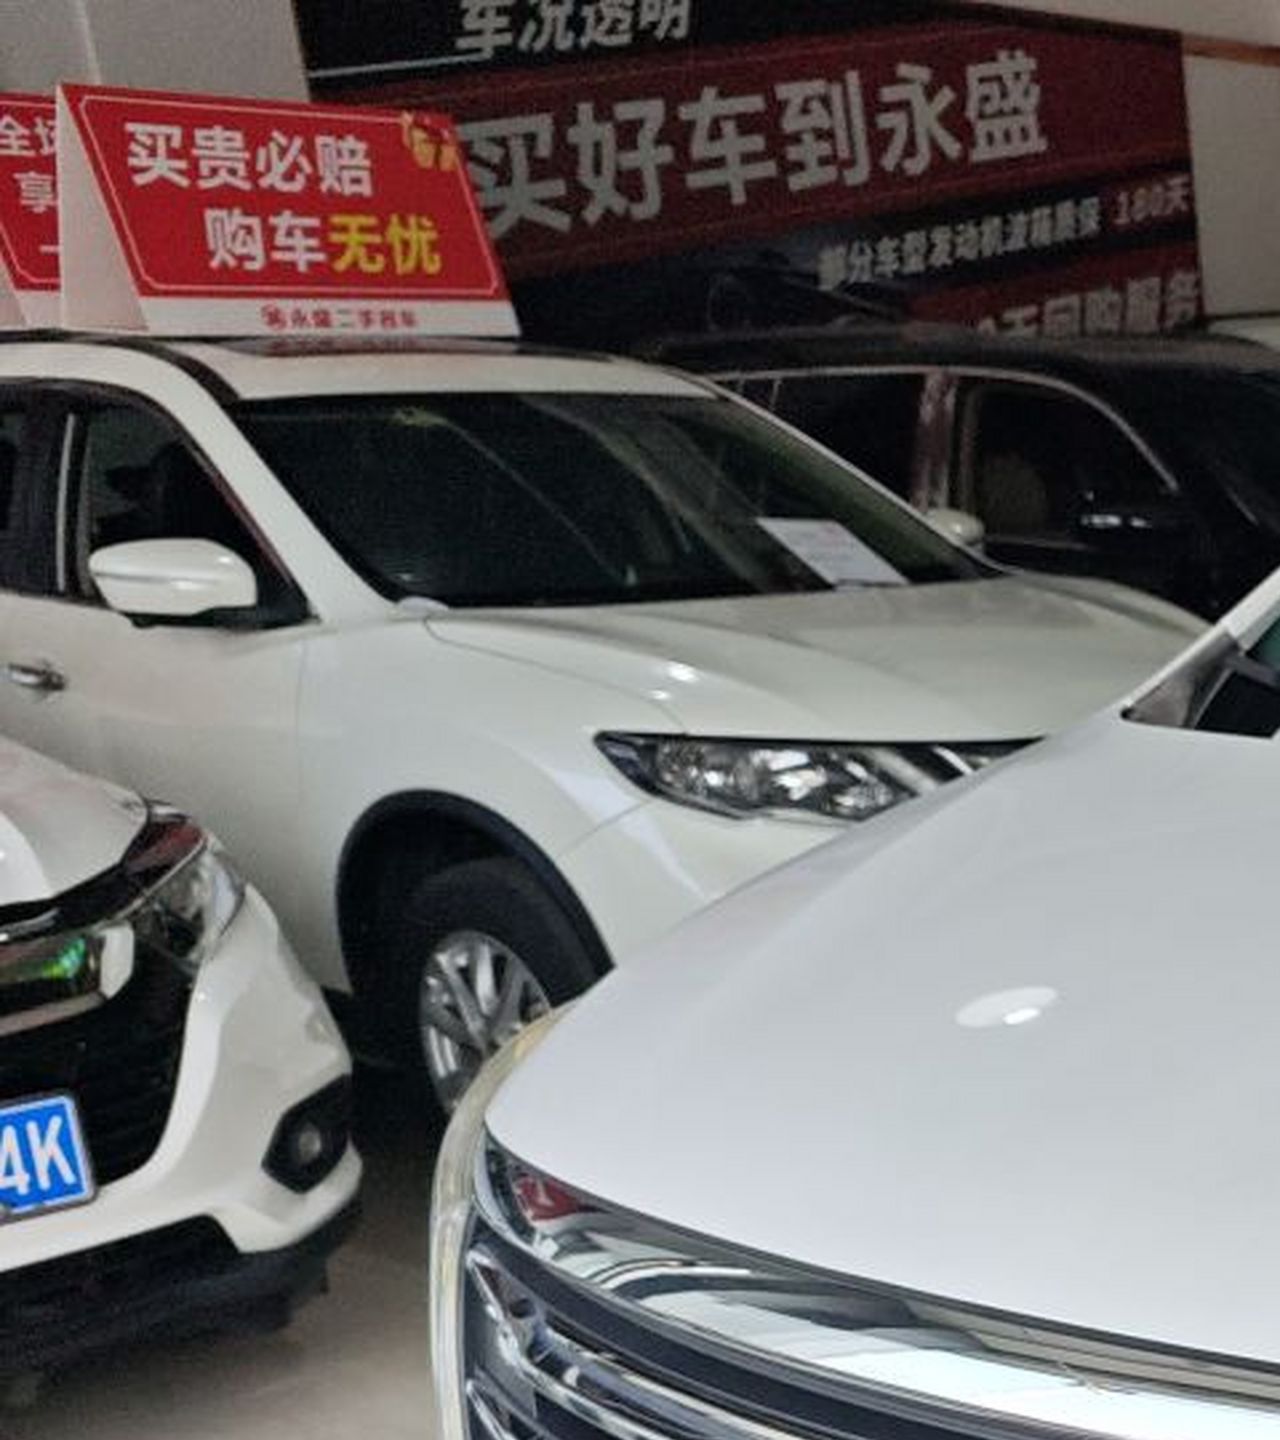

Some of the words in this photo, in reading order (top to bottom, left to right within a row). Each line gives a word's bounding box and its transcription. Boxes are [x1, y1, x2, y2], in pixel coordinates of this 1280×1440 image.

[454, 0, 692, 57] 车况透明
[125, 121, 373, 197] 买贵必赔
[455, 49, 1047, 237] 买好车到永盛
[203, 207, 442, 275] 购车无忧
